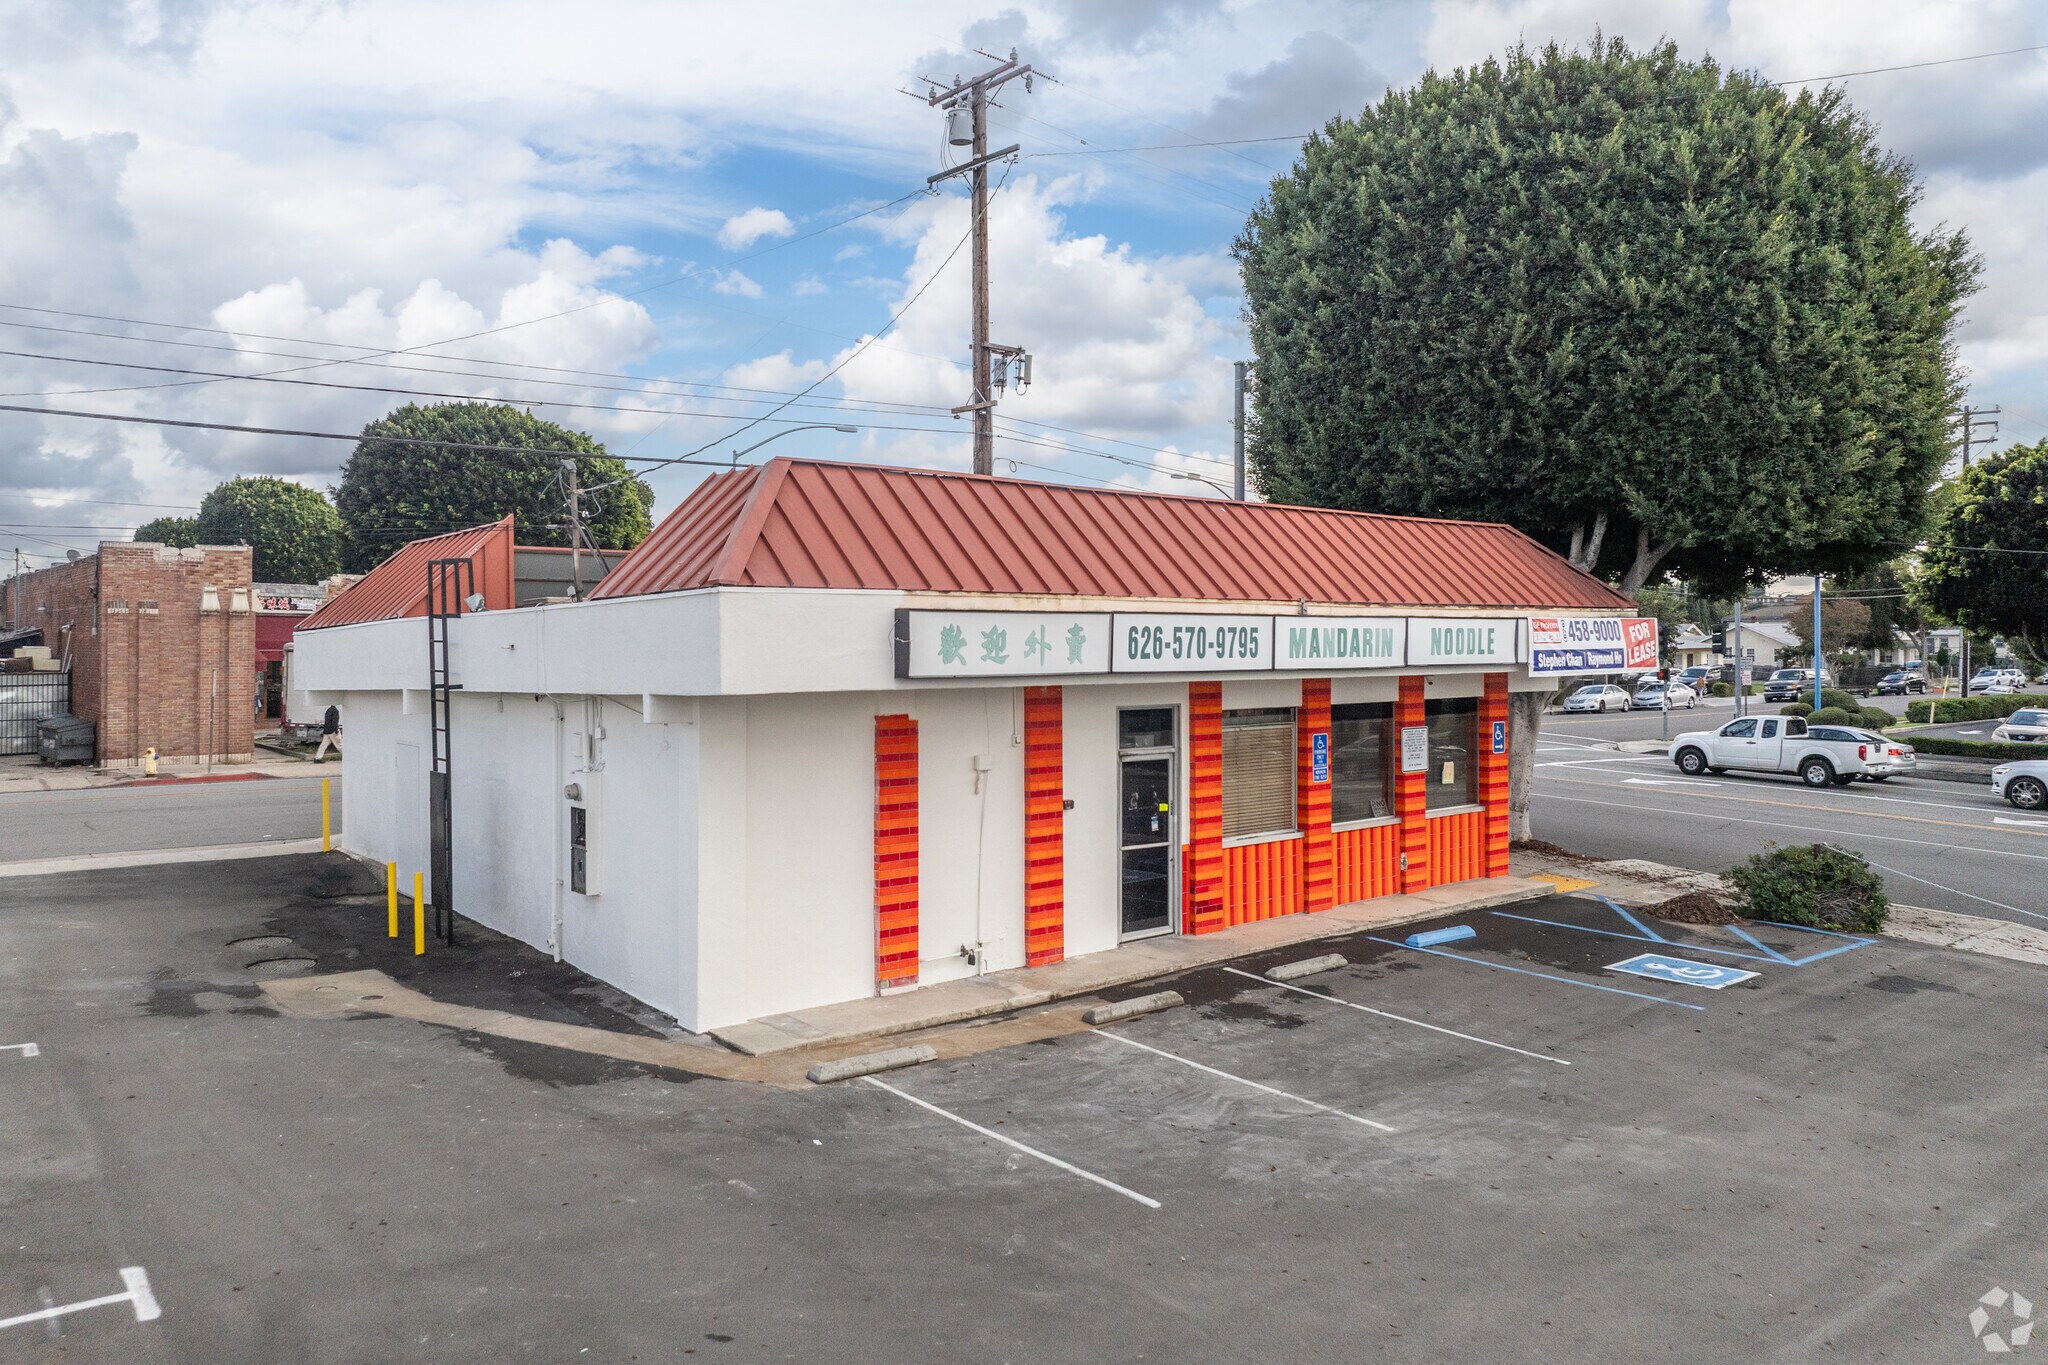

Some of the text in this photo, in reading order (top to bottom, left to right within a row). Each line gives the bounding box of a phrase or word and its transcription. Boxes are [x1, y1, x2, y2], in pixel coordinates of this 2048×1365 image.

[1127, 625, 1260, 660] 626-570-9795
[1568, 620, 1621, 642] 458-9000
[1629, 622, 1651, 642] FOR
[1288, 627, 1495, 659] MANDARIN NOODLE
[1628, 640, 1656, 665] LEASE
[1538, 650, 1623, 670] Stephen Chan Raymond Ho
